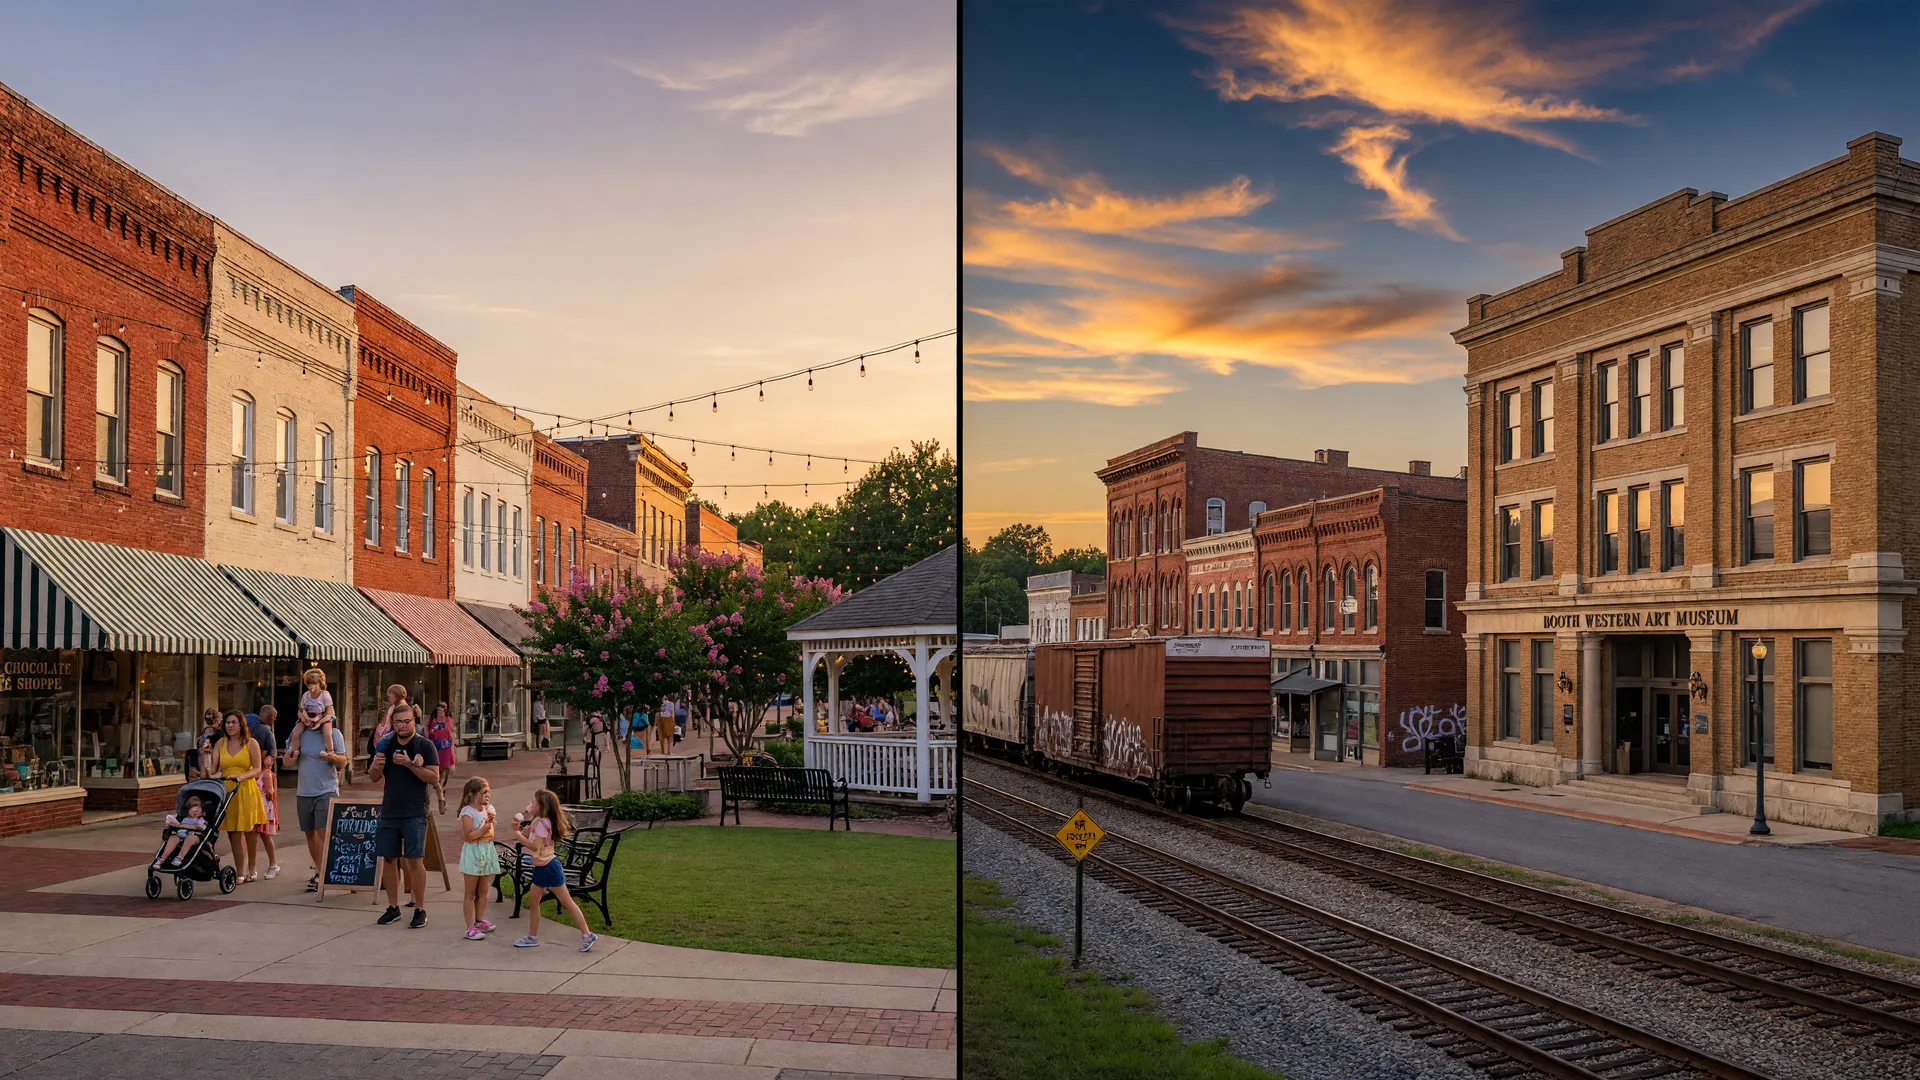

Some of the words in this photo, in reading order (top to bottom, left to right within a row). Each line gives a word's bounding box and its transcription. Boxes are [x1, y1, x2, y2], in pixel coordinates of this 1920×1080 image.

[1543, 614, 1581, 629] BOOTH
[1585, 612, 1641, 628] WESTERN
[1645, 611, 1671, 627] ART
[1676, 609, 1739, 626] MUSEUM
[4, 661, 72, 675] CHOCOLATE
[17, 677, 63, 690] SHOPPE
